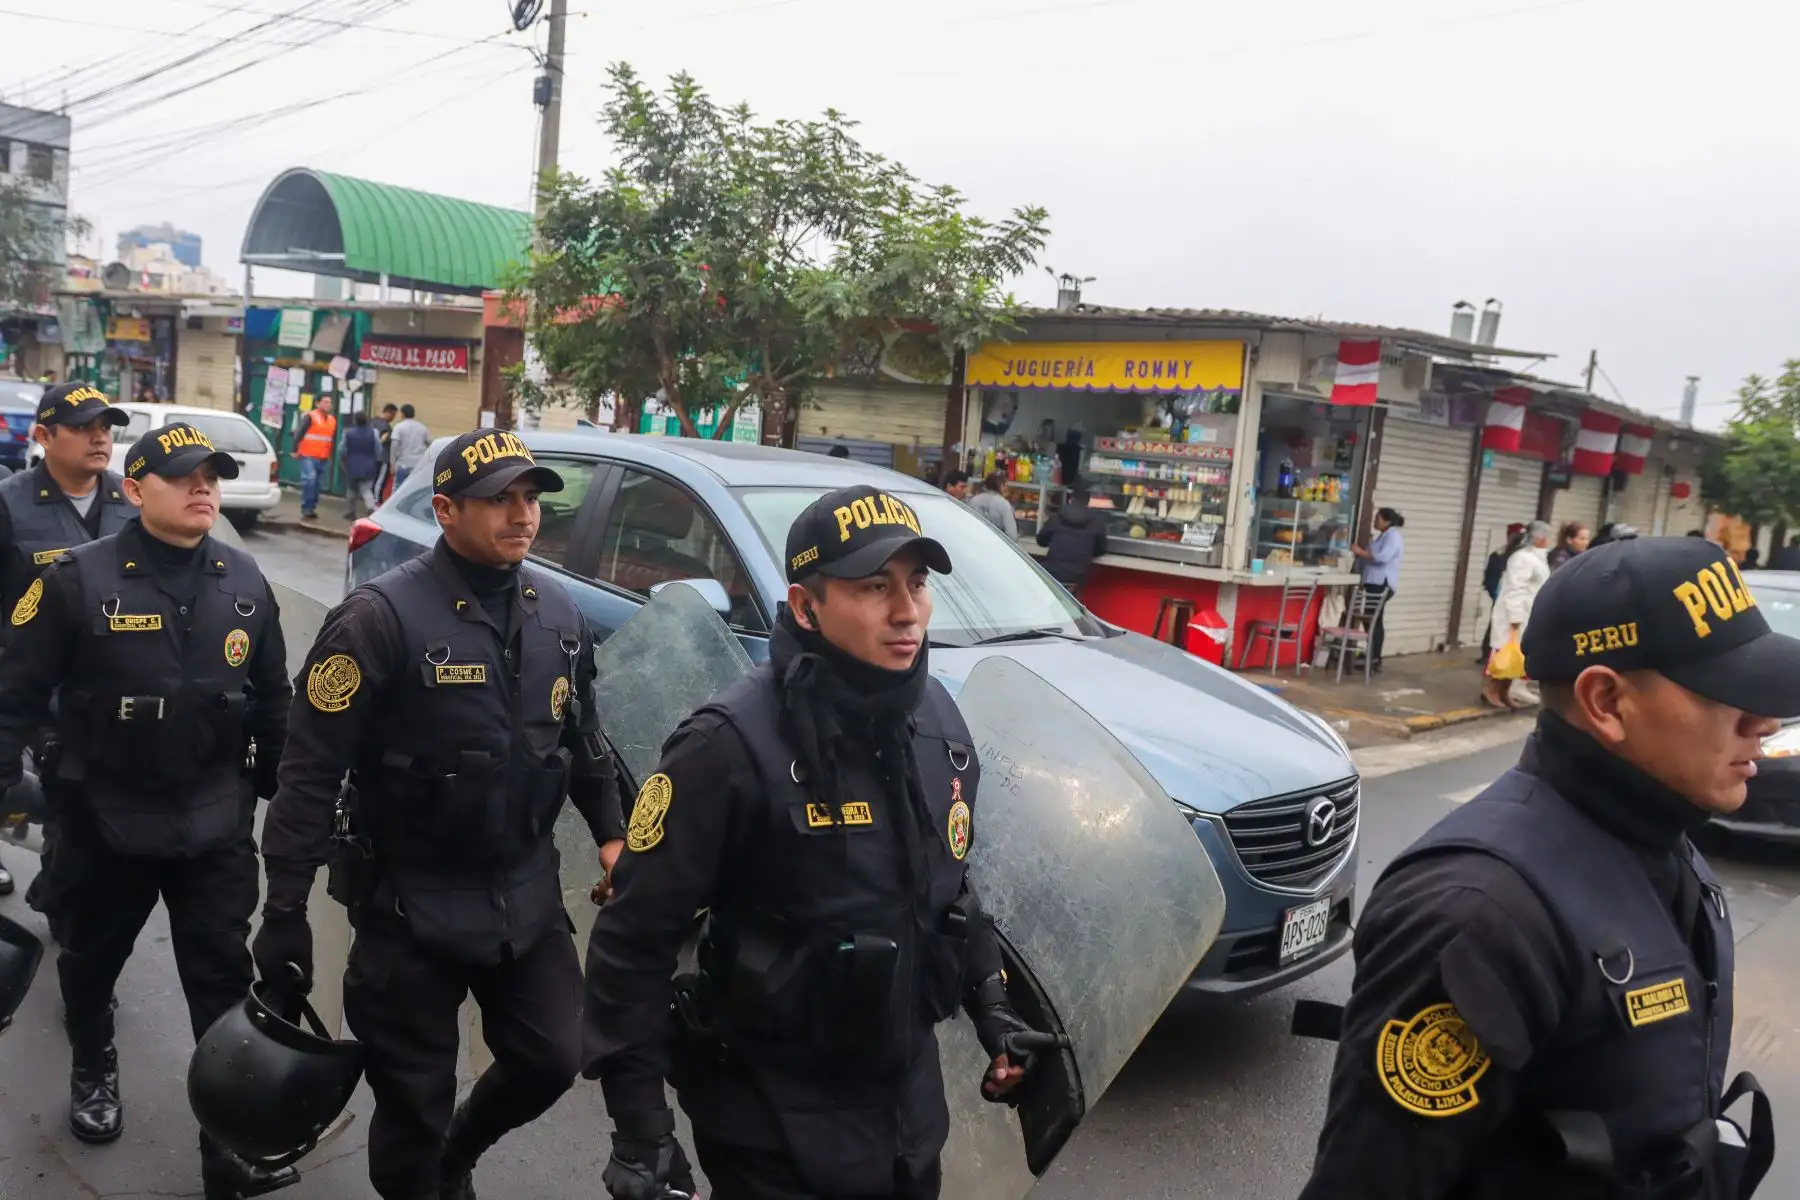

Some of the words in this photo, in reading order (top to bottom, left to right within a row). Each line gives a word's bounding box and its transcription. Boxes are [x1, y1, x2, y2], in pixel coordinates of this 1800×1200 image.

[425, 348, 456, 365] PASO
[1003, 356, 1095, 378] JUGUERÍA
[1124, 359, 1193, 378] ROMMY
[128, 456, 146, 476] PERU
[436, 468, 452, 487] PERU
[791, 545, 820, 571] PERU
[1573, 622, 1639, 656] PERU
[1282, 909, 1327, 952] APS-028
[1388, 1074, 1432, 1109] POLICIAL
[1435, 1094, 1465, 1109] LIMA
